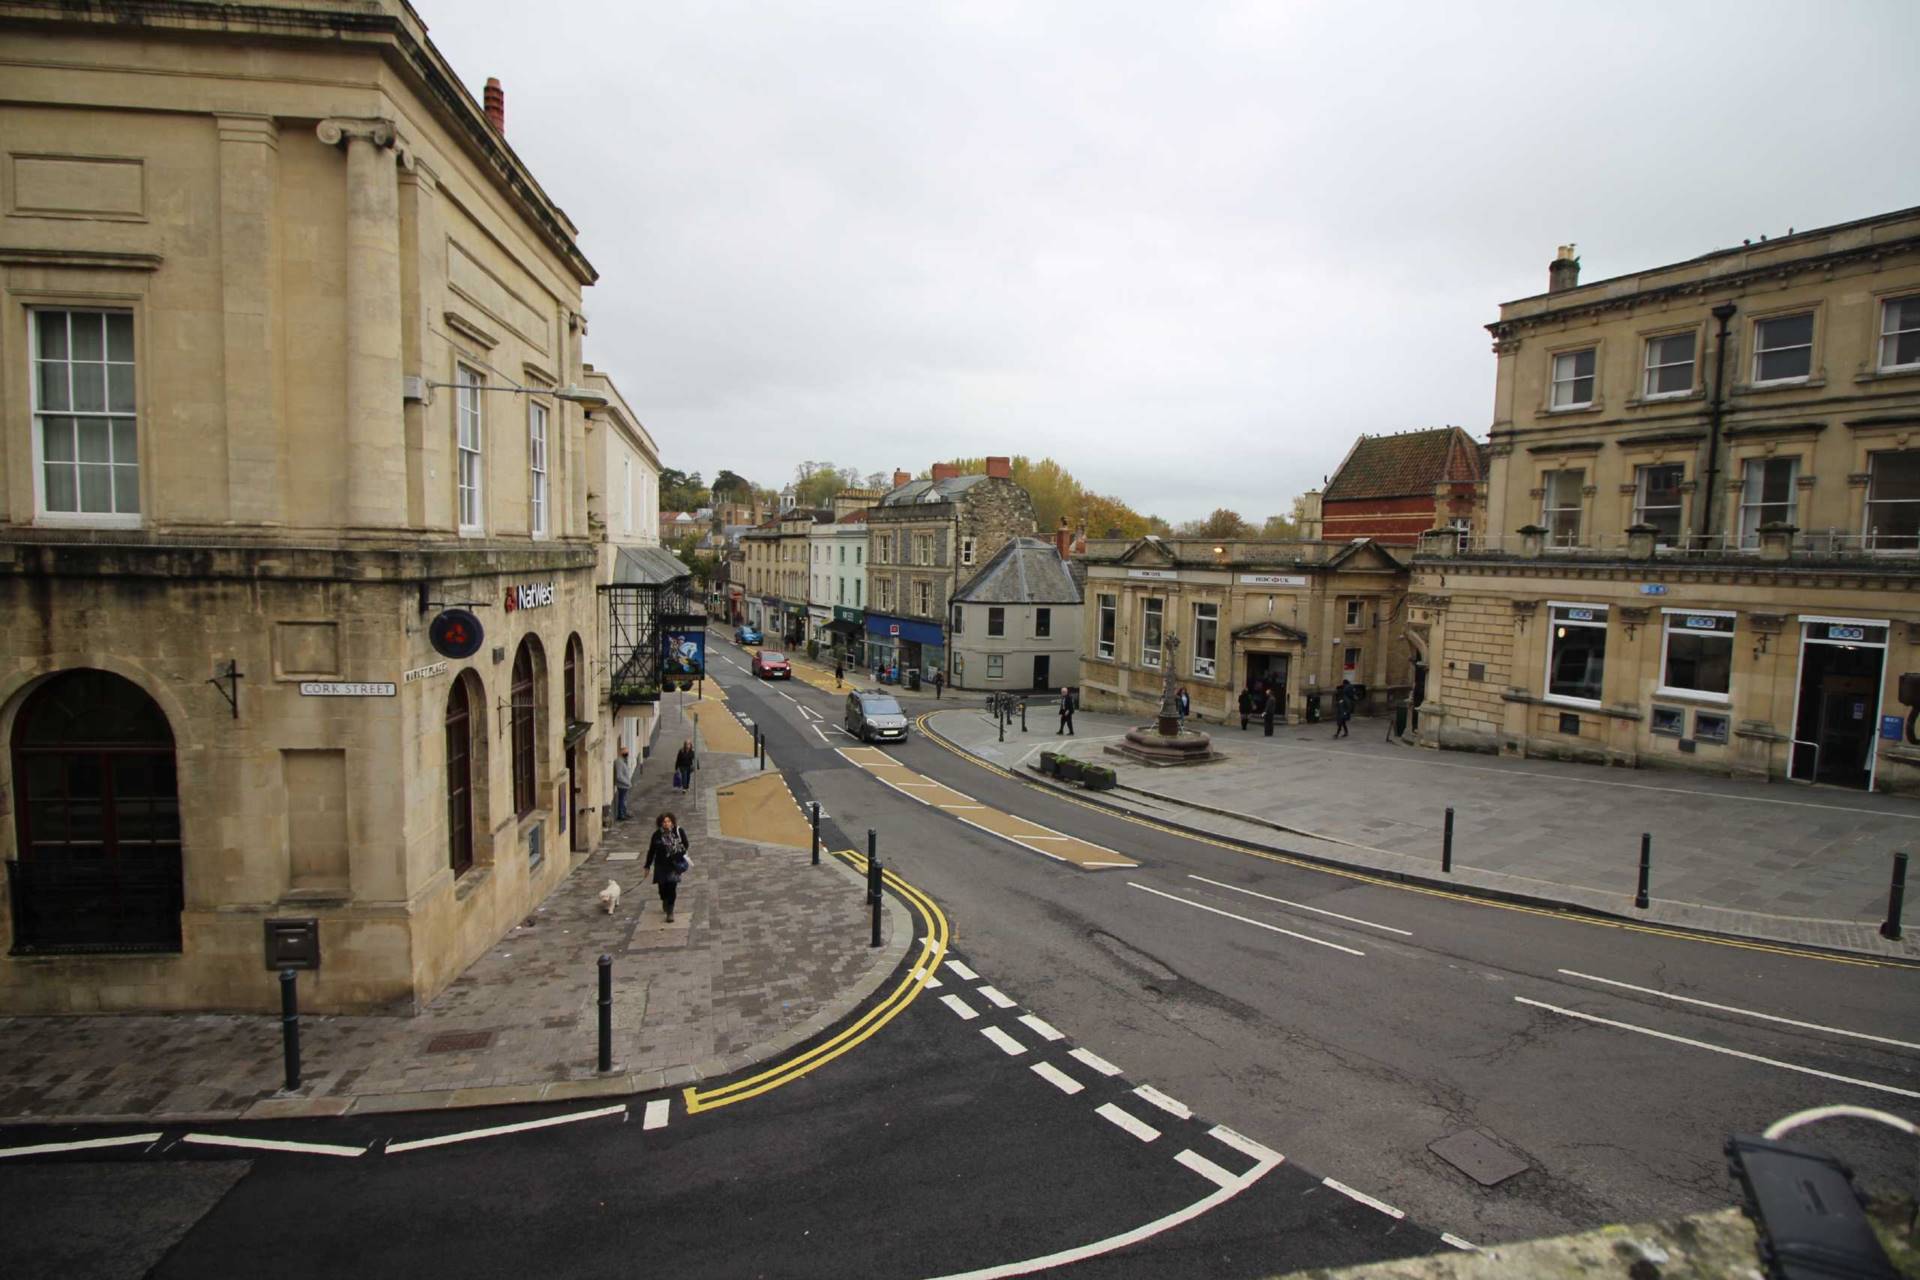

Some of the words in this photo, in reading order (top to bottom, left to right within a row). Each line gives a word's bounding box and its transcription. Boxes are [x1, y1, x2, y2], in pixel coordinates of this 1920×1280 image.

[518, 582, 554, 609] NatWest
[303, 684, 340, 694] CORK
[344, 684, 391, 694] STREET
